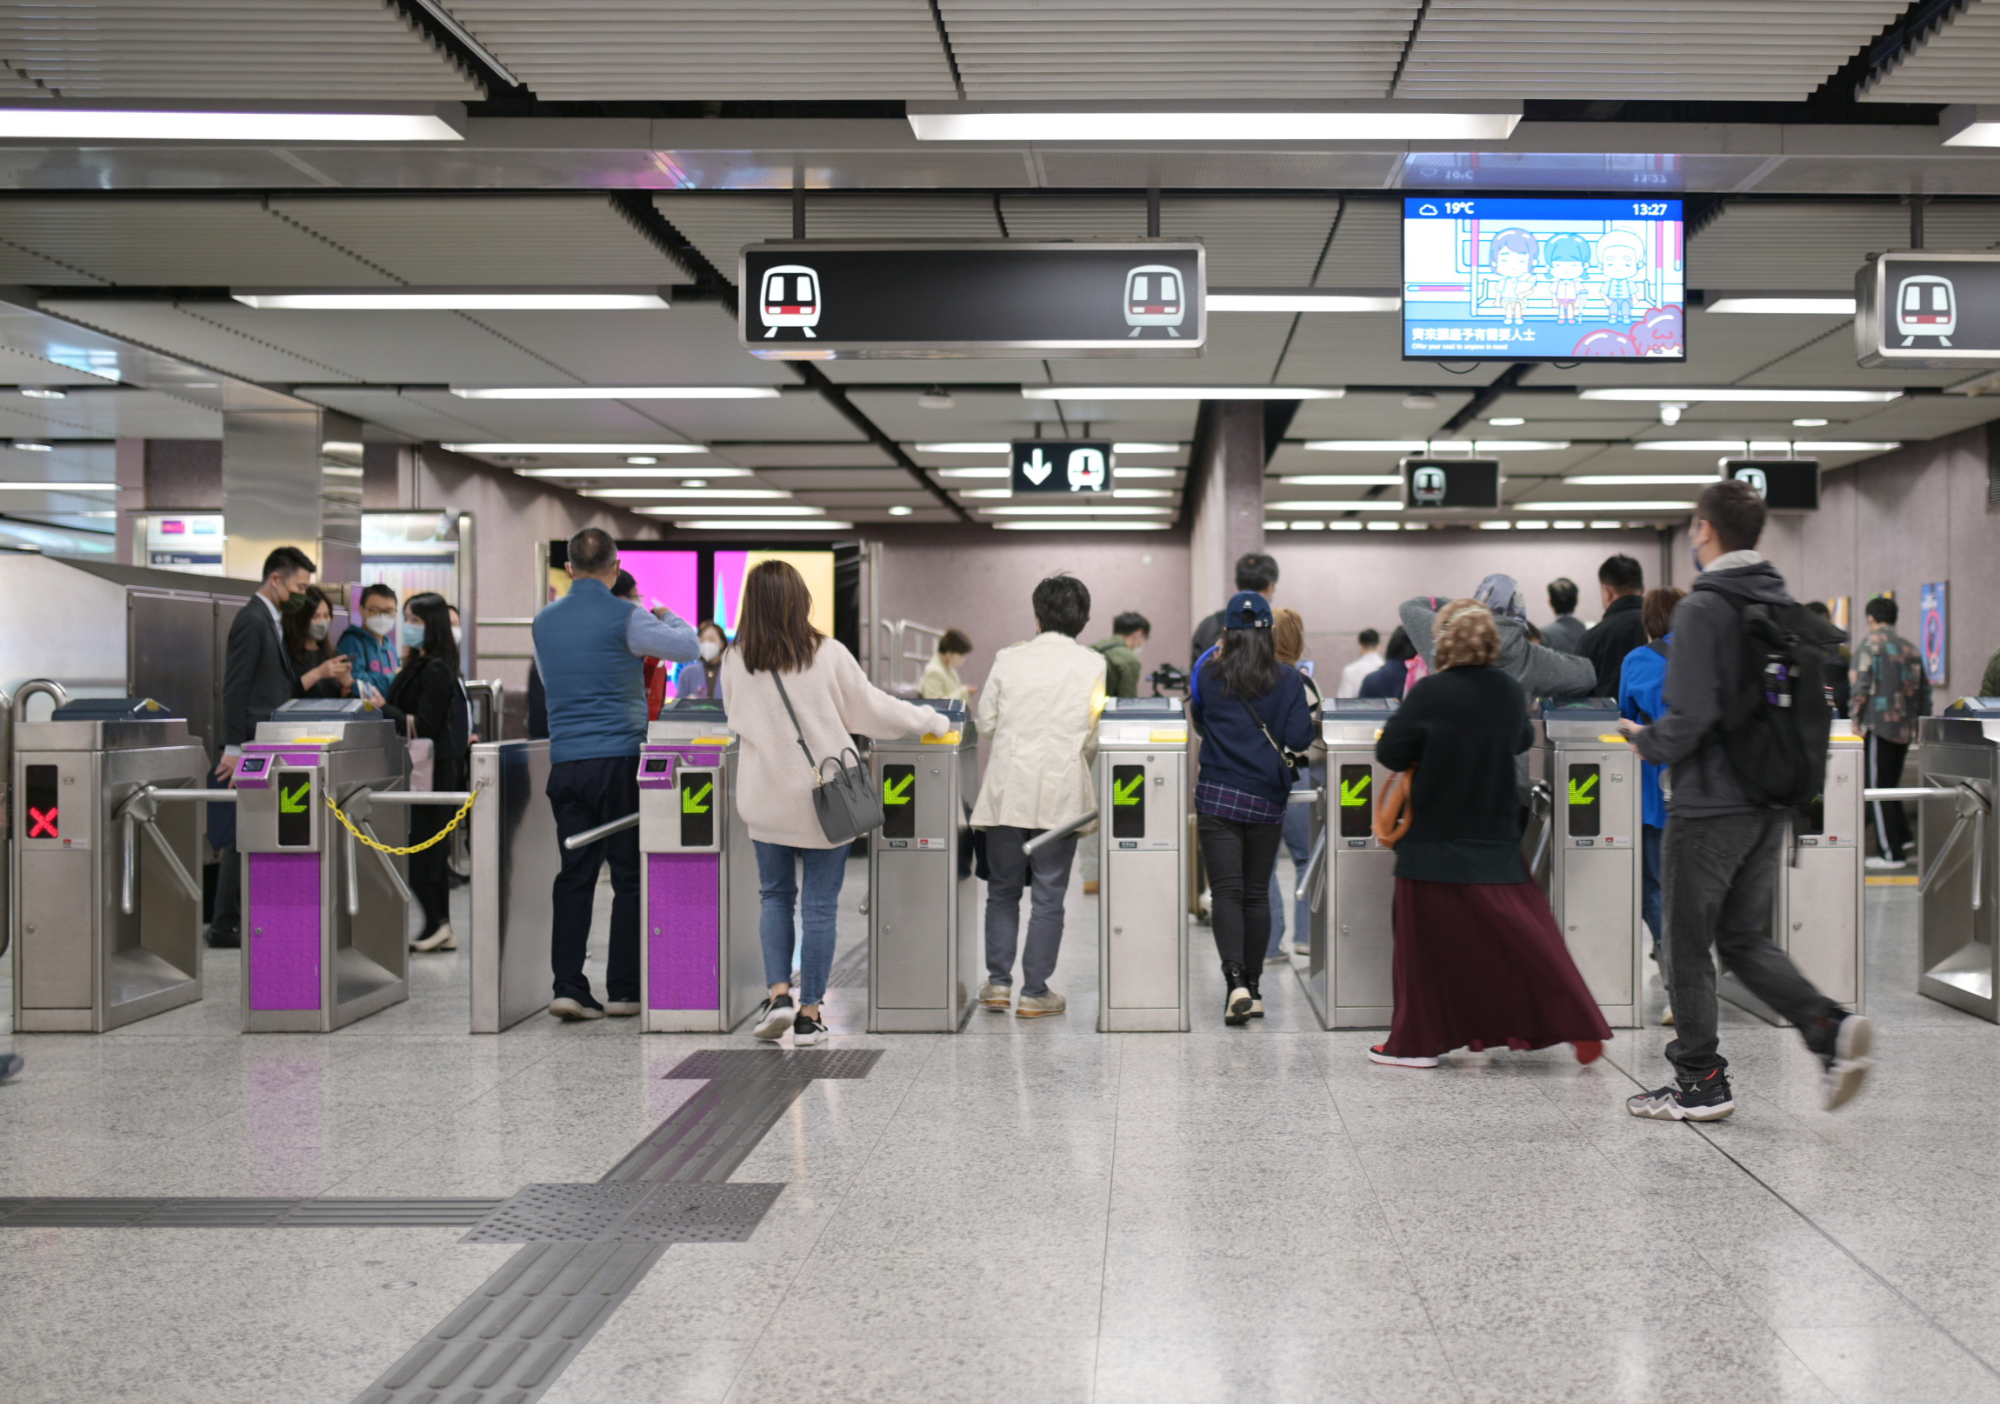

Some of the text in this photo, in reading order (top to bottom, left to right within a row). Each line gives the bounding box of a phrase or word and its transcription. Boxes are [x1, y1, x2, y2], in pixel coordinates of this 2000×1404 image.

[1445, 202, 1474, 214] 19°C
[1633, 203, 1667, 216] 13:27
[1464, 343, 1485, 351] anyone
